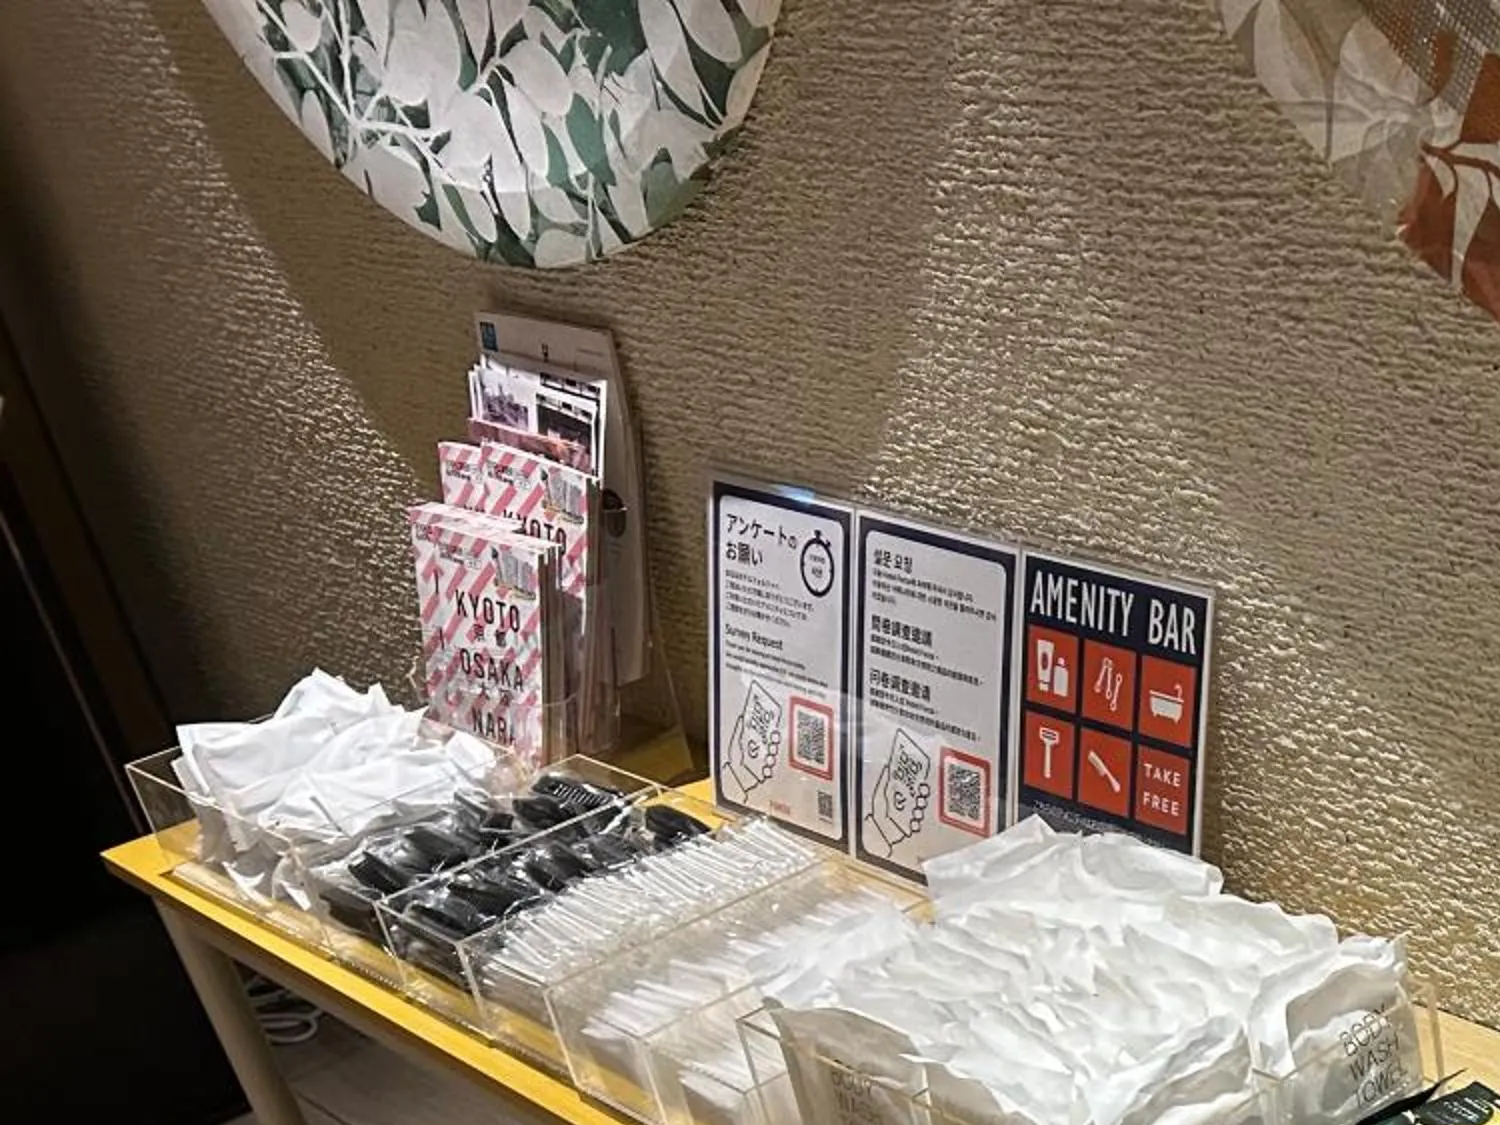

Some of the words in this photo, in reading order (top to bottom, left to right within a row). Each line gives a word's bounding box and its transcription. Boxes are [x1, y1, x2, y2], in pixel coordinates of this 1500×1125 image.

[726, 512, 796, 551] アンケートの
[726, 540, 762, 569] お願い
[893, 552, 913, 576] 요청
[456, 589, 520, 632] KYOTO
[1029, 567, 1134, 638] AMENITY
[1147, 598, 1199, 656] BAR
[751, 630, 782, 650] Request
[460, 648, 523, 692] OSAKA
[1143, 762, 1182, 788] TAKE
[1142, 792, 1180, 817] FREE
[1339, 1004, 1391, 1057] BODY
[1350, 1031, 1400, 1081] WASH
